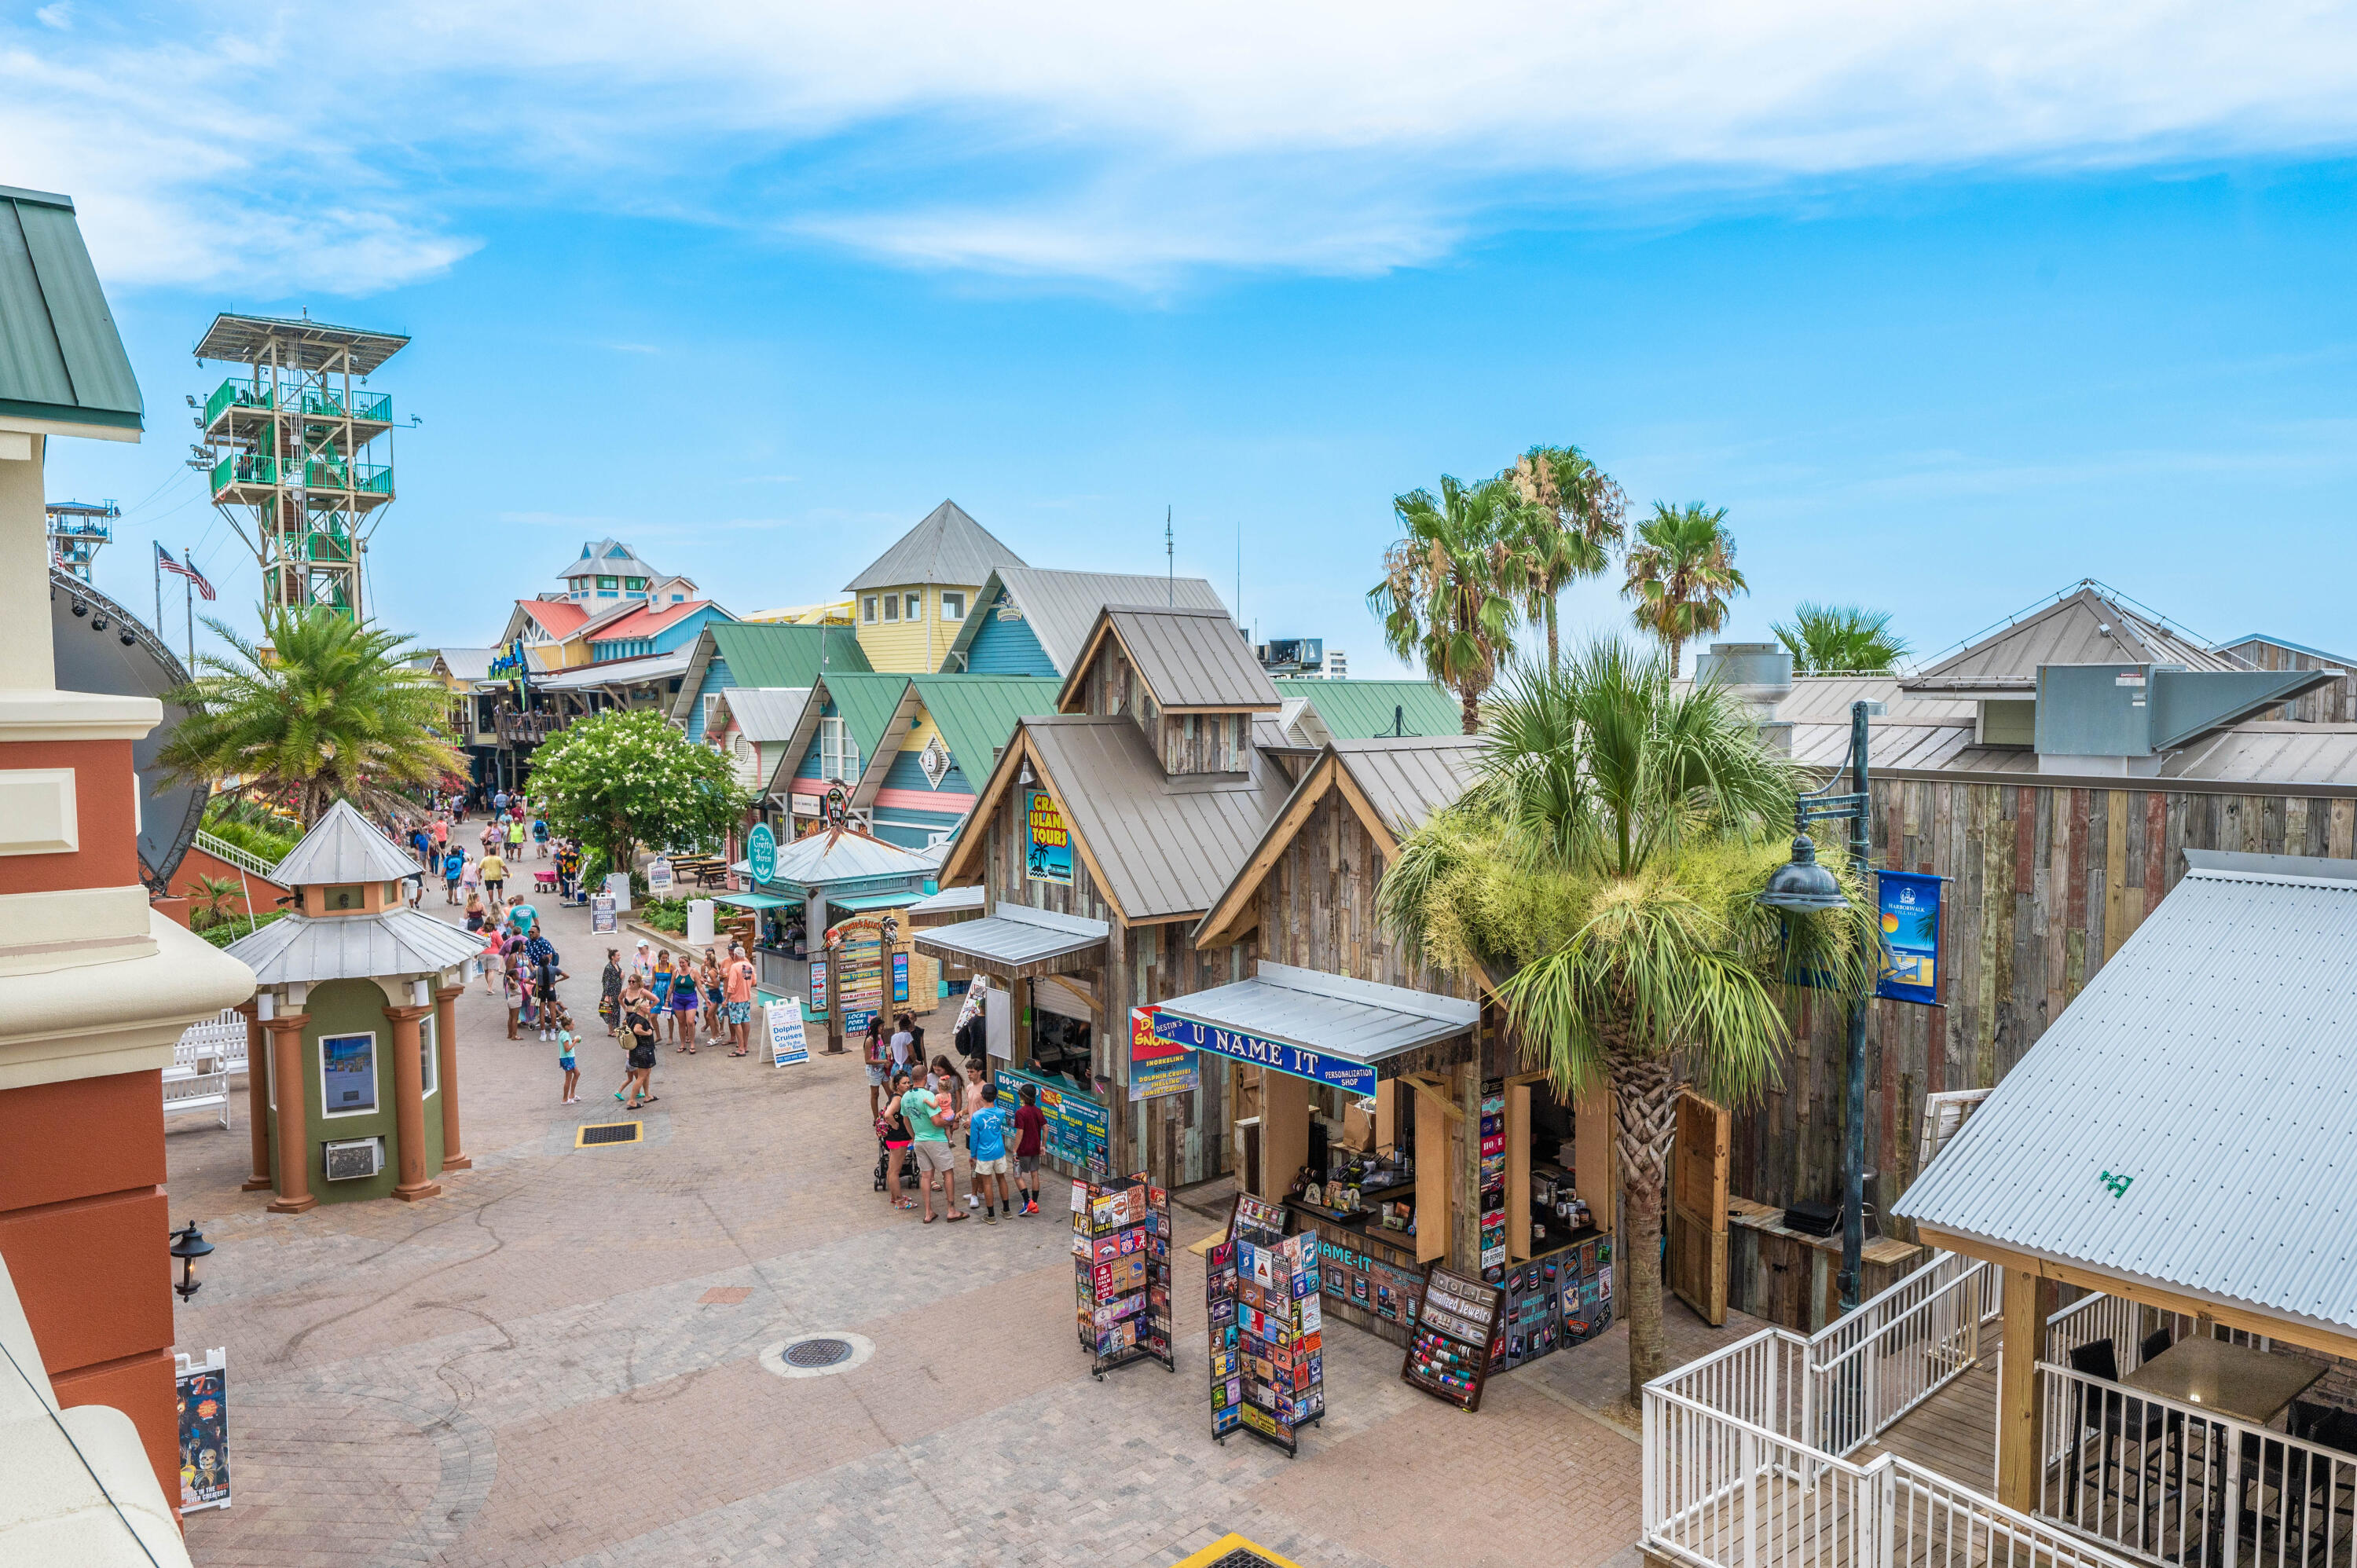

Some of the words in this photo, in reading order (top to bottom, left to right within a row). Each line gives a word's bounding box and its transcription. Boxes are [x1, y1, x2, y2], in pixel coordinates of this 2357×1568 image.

[1032, 828, 1067, 847] TOURS
[752, 835, 772, 855] Crafty
[754, 848, 772, 862] Siren
[838, 920, 863, 934] PIRATE'S
[863, 919, 882, 929] ALLEY
[773, 1024, 801, 1034] Dolphin
[1156, 1020, 1182, 1032] DESTIN'S
[775, 1032, 803, 1042] Cruises
[1192, 1024, 1205, 1044] U
[1215, 1029, 1282, 1066] NAME
[1294, 1050, 1318, 1075] IT
[1146, 1055, 1184, 1067] SNORKELING
[1138, 1072, 1167, 1083] DOLPHIN
[1168, 1068, 1191, 1077] CRUISES
[1325, 1069, 1373, 1079] PERSONALIZATION
[1151, 1078, 1180, 1087] SHELLING
[1142, 1088, 1164, 1097] SUNSET
[1165, 1083, 1188, 1092] CRUISES
[1070, 1117, 1083, 1126] ISLAND
[1087, 1123, 1105, 1134] DOLPHIN
[1490, 1251, 1504, 1262] PEPPER
[1393, 1277, 1409, 1288] SHOP
[1351, 1295, 1369, 1308] BRACELETS
[1426, 1286, 1459, 1312] ersonalized
[1459, 1300, 1492, 1324] Jewelry
[202, 1489, 226, 1500] CREATED?
